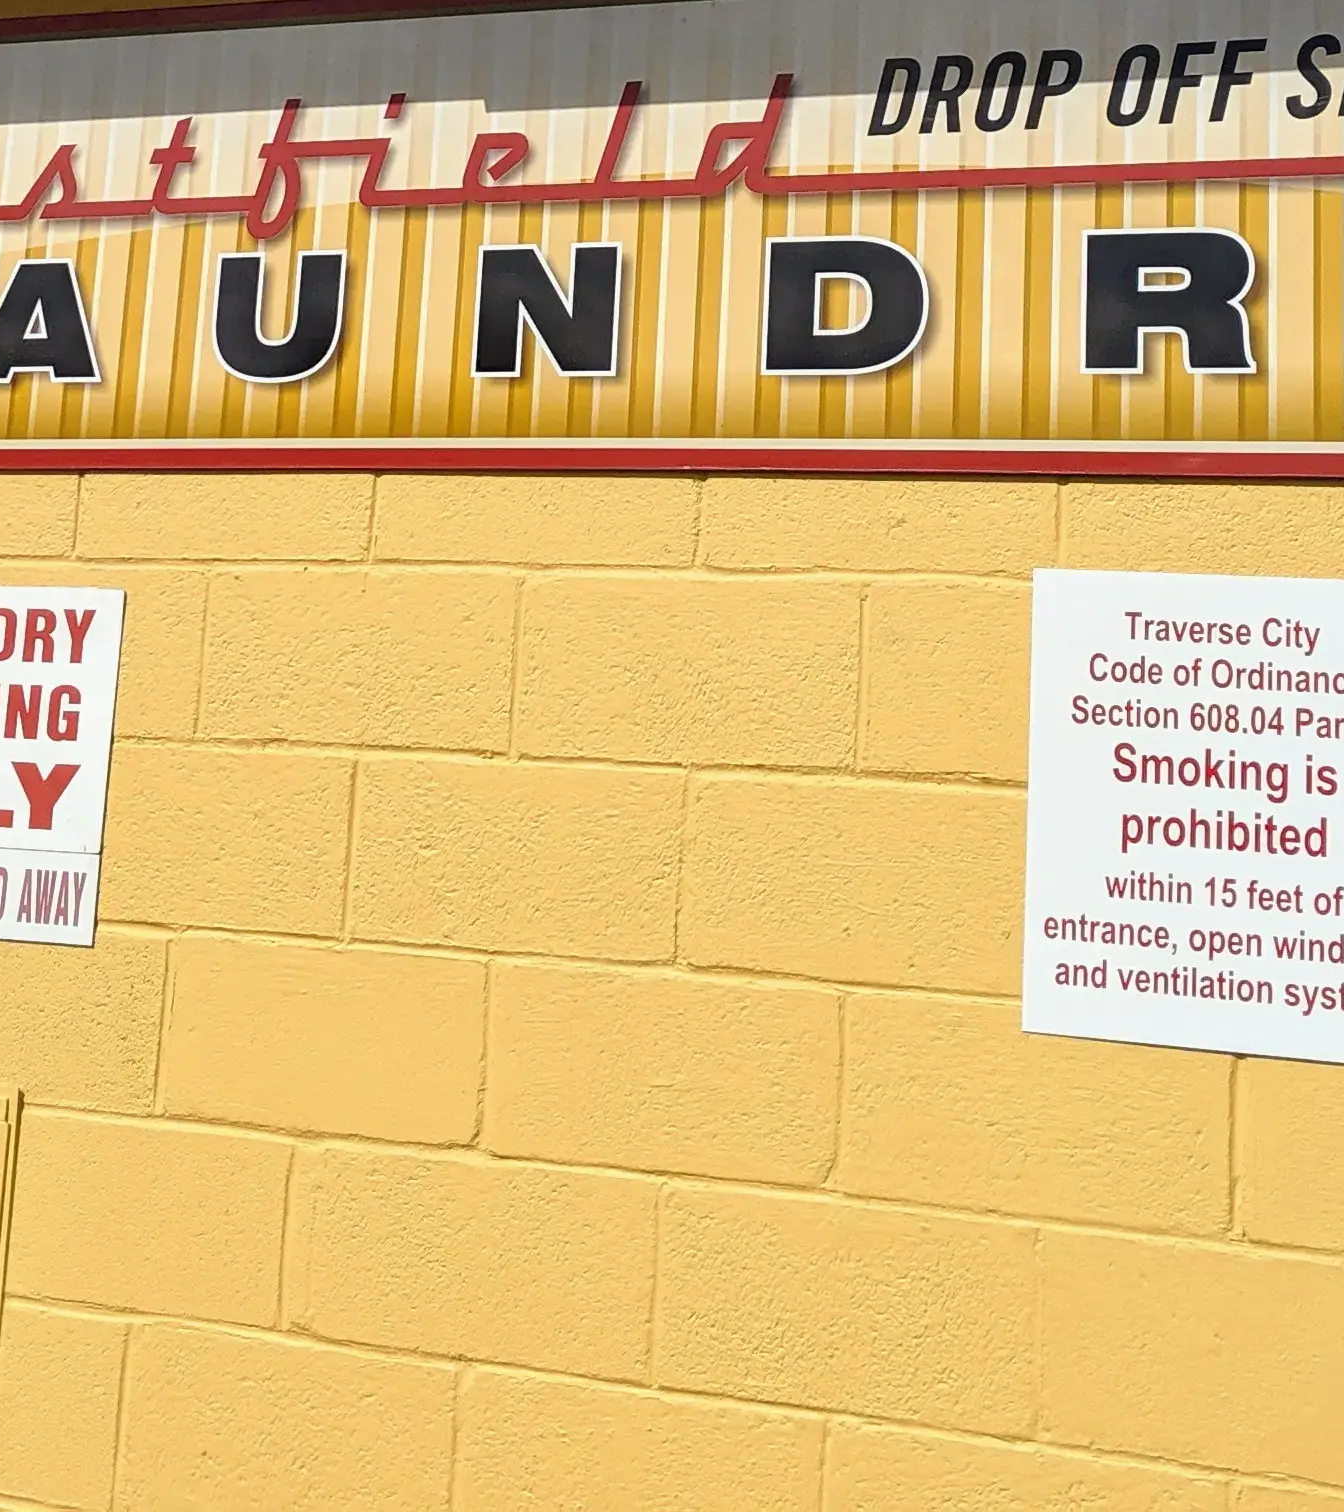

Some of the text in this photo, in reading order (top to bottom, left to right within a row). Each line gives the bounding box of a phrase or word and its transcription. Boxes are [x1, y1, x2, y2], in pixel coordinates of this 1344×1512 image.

[867, 50, 1083, 137] DROP
[1106, 38, 1266, 126] OFF
[1125, 611, 1320, 656] Traverse City
[1089, 653, 1163, 685] Code
[1173, 658, 1202, 687] of
[1071, 695, 1179, 730] Section
[1190, 703, 1284, 736] 608.04
[1112, 742, 1339, 804] Smoking is
[1121, 808, 1328, 857] prohibited
[16, 868, 87, 927] AWAY
[1105, 870, 1344, 916] within 15 feet of
[1043, 913, 1178, 955] entrance,
[1189, 928, 1262, 961] open
[1055, 960, 1107, 989] and
[1117, 965, 1273, 1004] ventilation
